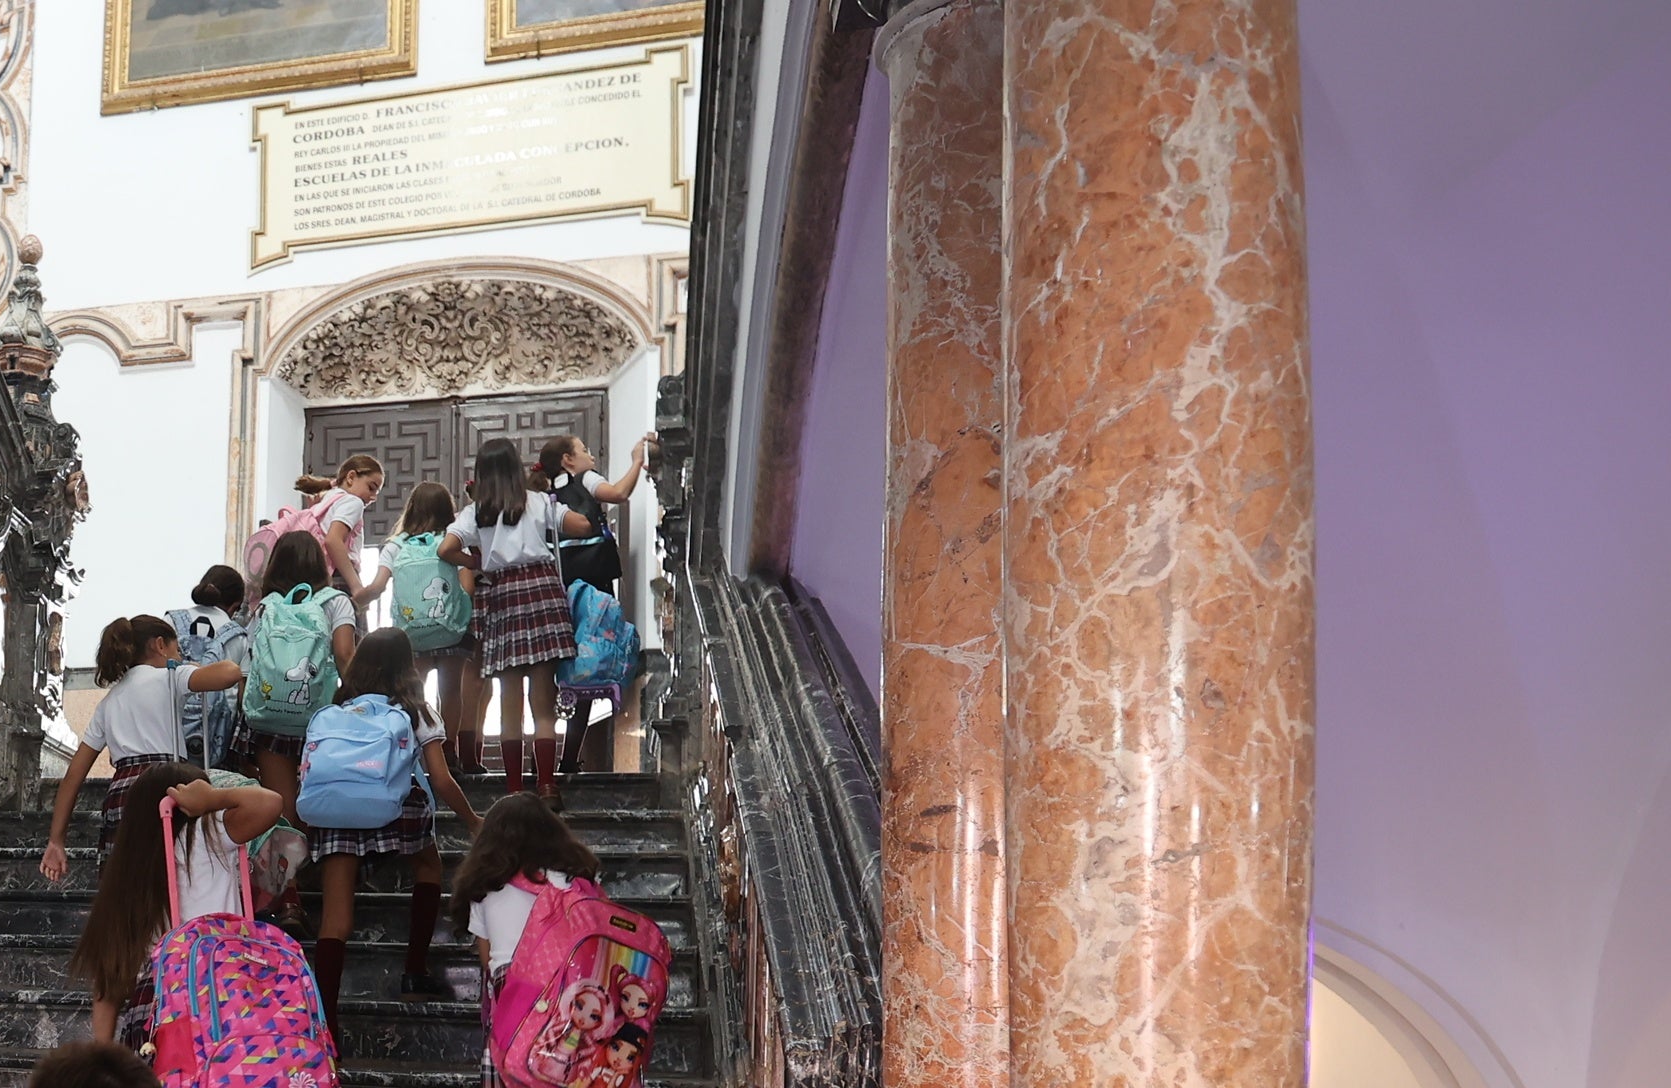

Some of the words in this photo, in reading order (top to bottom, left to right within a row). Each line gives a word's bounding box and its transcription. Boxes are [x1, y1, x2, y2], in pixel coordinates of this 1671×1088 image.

[294, 119, 305, 130] EN
[306, 117, 324, 128] ESTE
[327, 112, 361, 125] EDIFICIO
[376, 99, 456, 118] FRANCISC
[619, 71, 642, 85] DE
[292, 125, 365, 144] CORDOBA
[372, 122, 394, 133] DEAN
[396, 120, 406, 130] DE
[578, 90, 630, 105] CONCEDIDO
[632, 89, 642, 98] EL
[294, 151, 308, 159] REY
[310, 144, 341, 157] CARLOS
[343, 144, 351, 152] III
[352, 143, 362, 151] LA
[364, 135, 409, 149] PROPIEDAD
[411, 133, 426, 144] DEL
[295, 161, 322, 173] BIENES
[324, 158, 348, 170] ESTAS
[352, 148, 408, 166] REALES
[293, 169, 367, 188] ESCUELAS
[370, 165, 391, 179] DE
[395, 163, 413, 176] LA
[294, 193, 305, 203] EN
[306, 191, 321, 201] LAS
[323, 189, 339, 200] QUE
[341, 187, 350, 197] SE
[352, 182, 394, 195] INICIARON
[396, 180, 411, 191] LAS
[412, 175, 444, 188] CLASES
[294, 207, 311, 217] SON
[313, 201, 354, 214] PATRONOS
[356, 200, 366, 210] DE
[367, 198, 386, 209] ESTE
[388, 193, 424, 206] COLEGIO
[294, 221, 310, 231] LOS
[360, 211, 405, 223] MAGISTRAL
[407, 209, 413, 218] Y
[414, 204, 457, 217] DOCTORAL
[460, 202, 470, 212] DE
[501, 193, 543, 207] CATEDRAL
[545, 192, 556, 202] DE
[558, 187, 602, 200] CORDOBA
